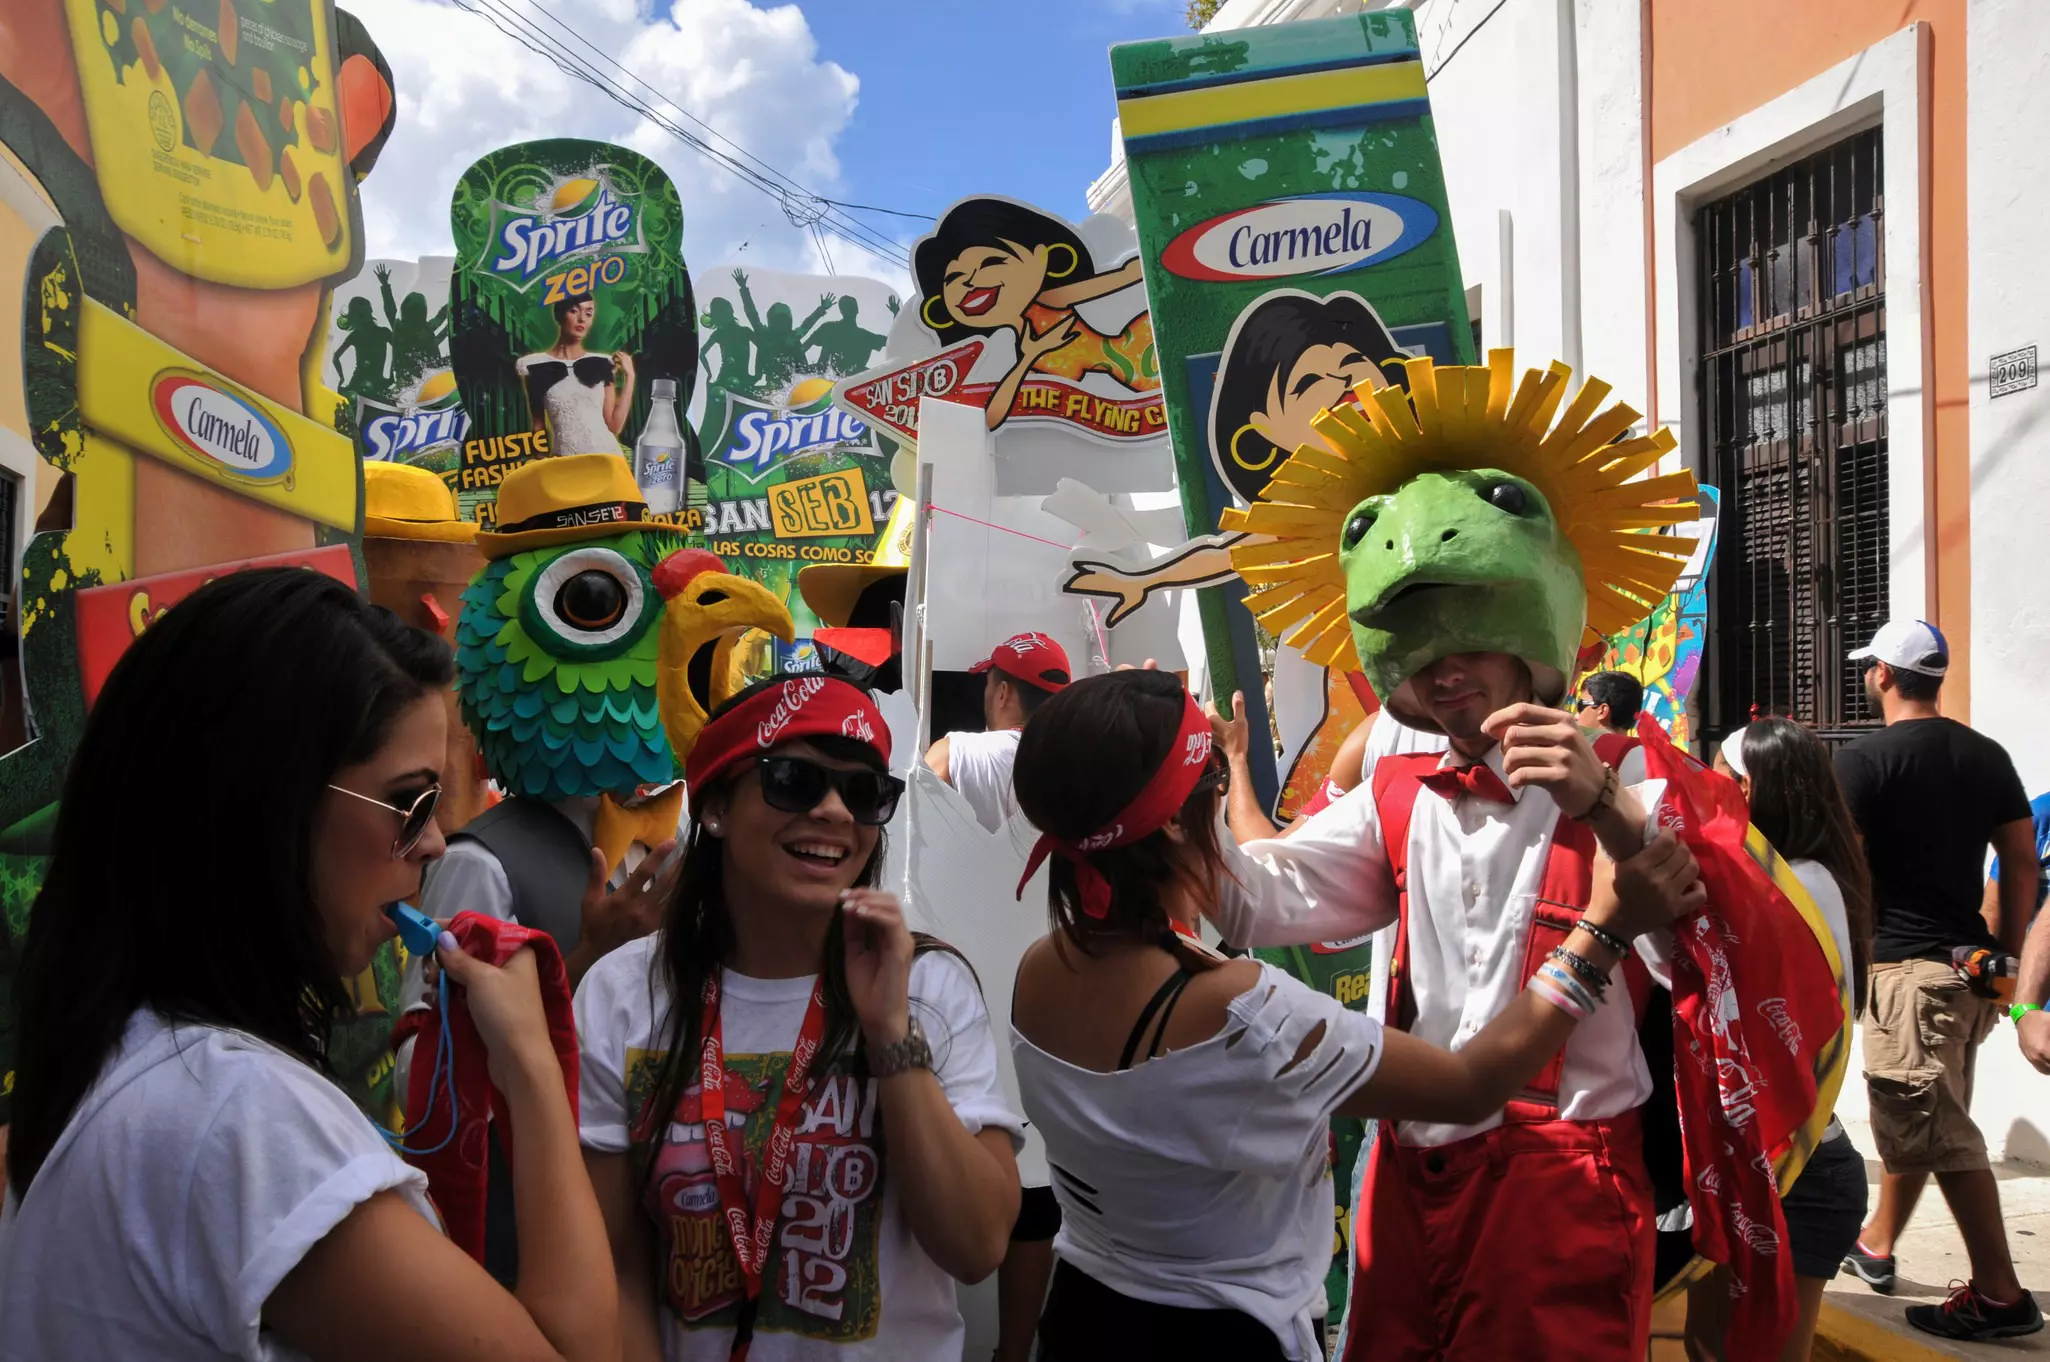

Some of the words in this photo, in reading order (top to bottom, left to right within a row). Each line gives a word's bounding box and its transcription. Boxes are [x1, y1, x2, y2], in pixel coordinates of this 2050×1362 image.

[495, 192, 632, 274] Sprite
[1229, 207, 1372, 268] Carmela
[543, 256, 625, 306] zero
[1999, 360, 2027, 384] 209
[866, 377, 893, 409] SAN
[1020, 387, 1061, 410] THE
[187, 396, 261, 463] Carmela
[883, 404, 920, 431] 201
[465, 430, 549, 464] FUISTE
[728, 404, 866, 468] Sprite
[462, 461, 525, 489] FASH
[643, 460, 676, 479] Sprite
[652, 473, 672, 484] zero
[475, 502, 498, 524] FI
[704, 497, 772, 535] SAN
[776, 475, 861, 533] SEB
[869, 489, 898, 521] 12
[713, 541, 741, 556] LAS
[744, 545, 796, 560] COSAS
[800, 547, 851, 562] COMO
[855, 550, 877, 564] SO
[681, 1186, 716, 1207] Carmela
